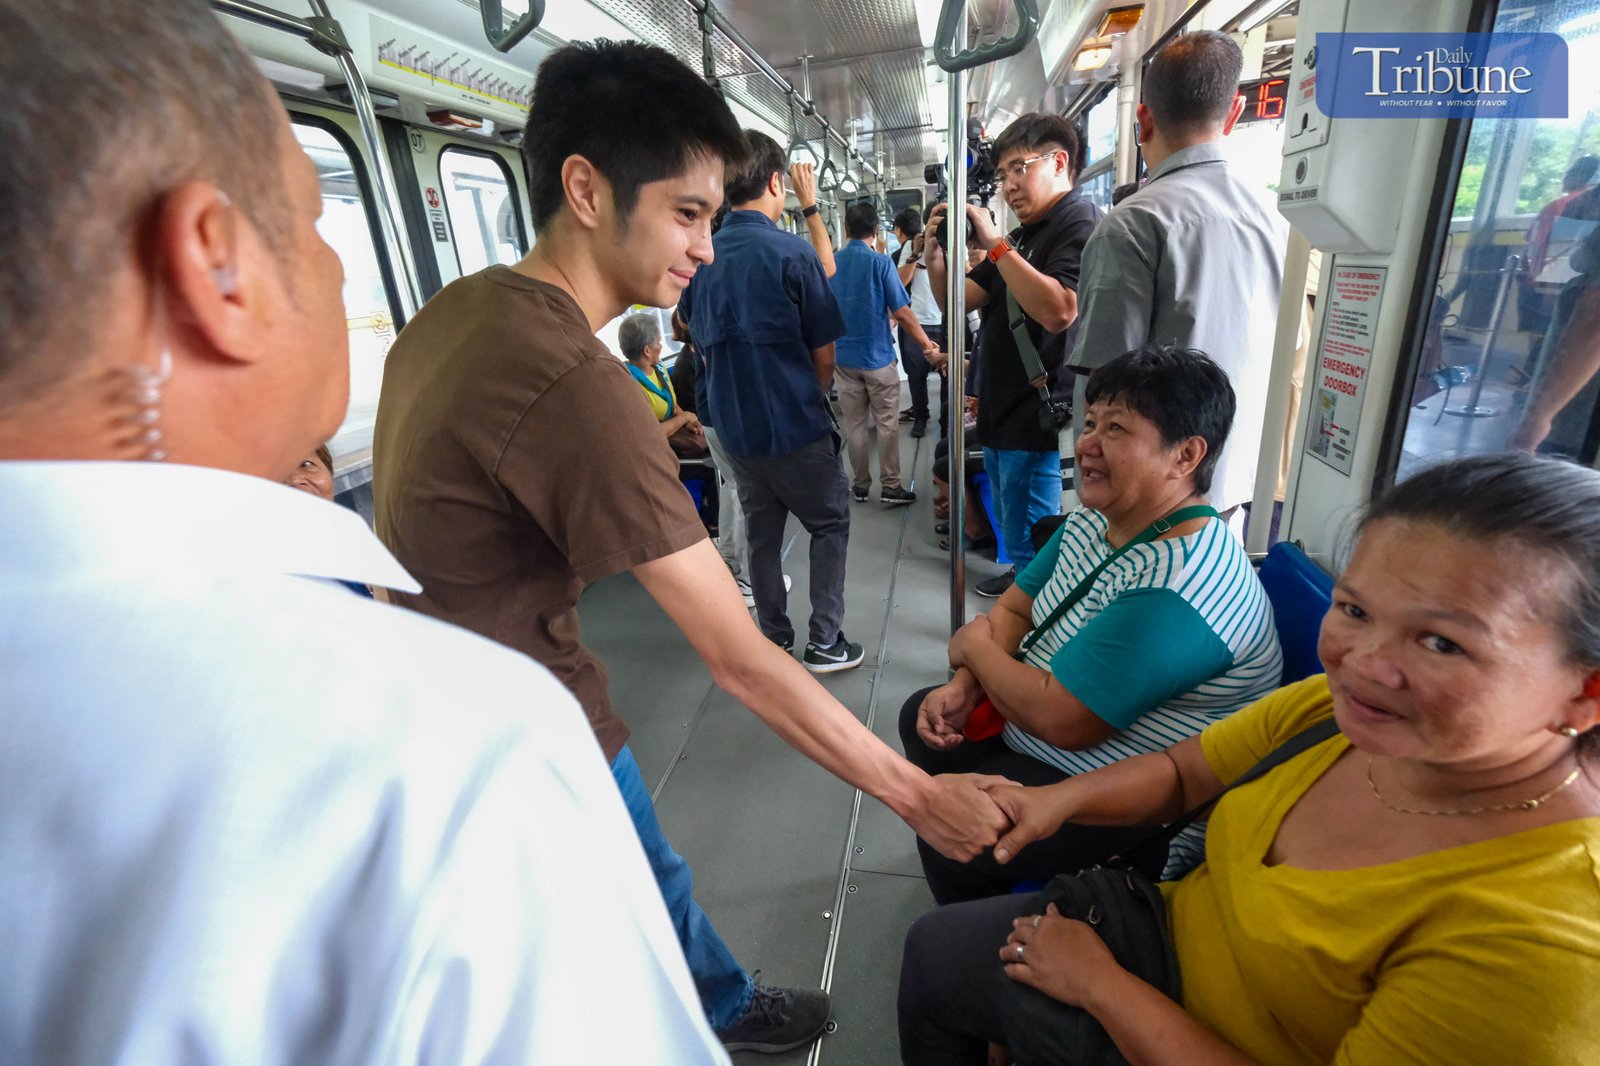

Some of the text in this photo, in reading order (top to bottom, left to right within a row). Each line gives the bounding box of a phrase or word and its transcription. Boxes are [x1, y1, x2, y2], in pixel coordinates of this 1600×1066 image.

[1301, 189, 1318, 199] DRIVER
[1323, 357, 1366, 379] EMERGENCY
[1324, 375, 1357, 397] DOORBOX
